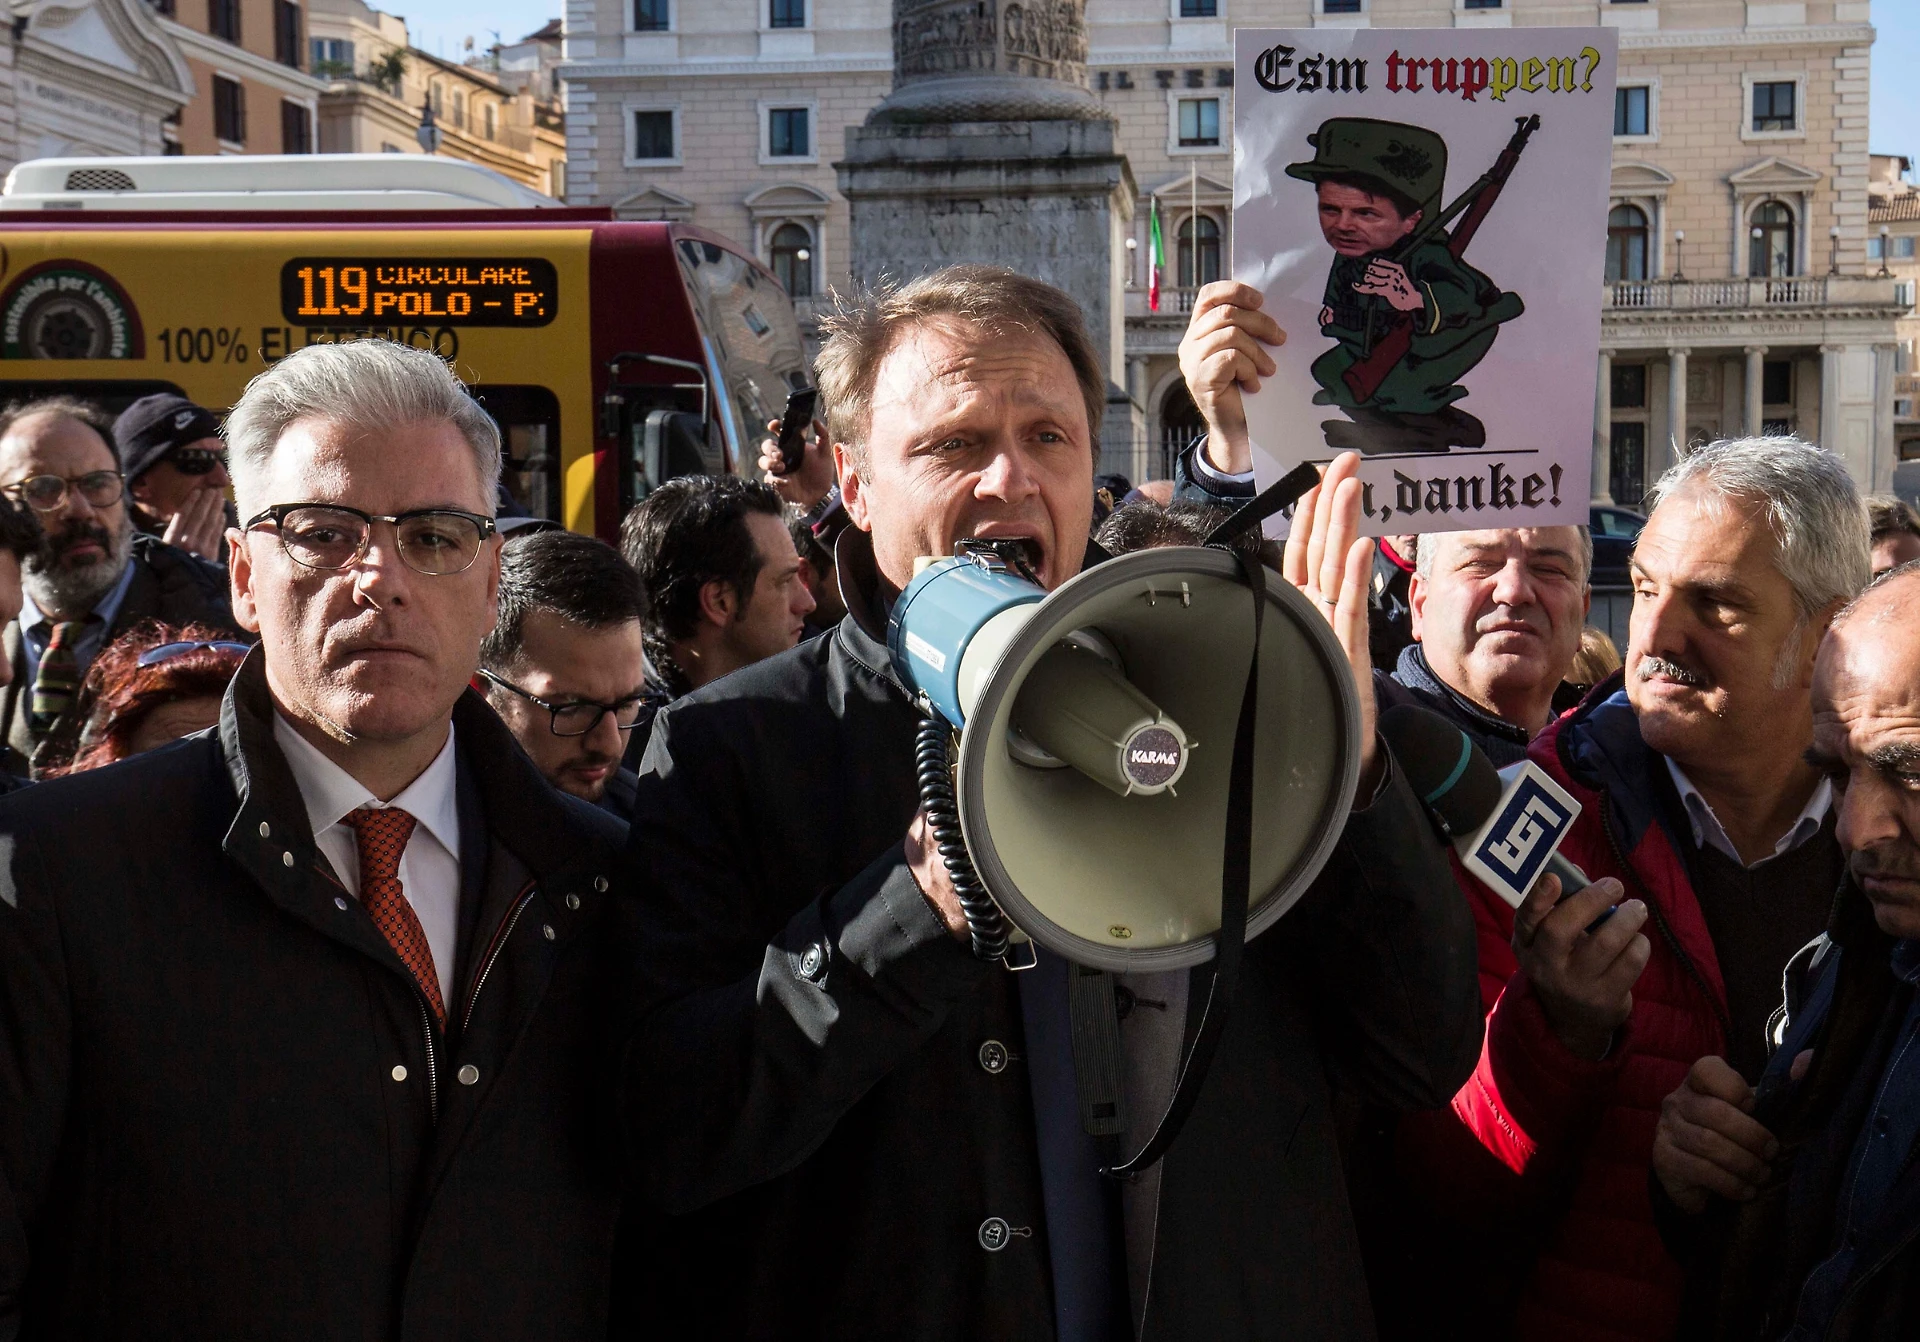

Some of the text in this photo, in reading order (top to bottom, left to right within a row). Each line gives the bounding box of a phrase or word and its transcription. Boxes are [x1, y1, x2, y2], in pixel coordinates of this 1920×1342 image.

[1099, 71, 1134, 89] IL
[1254, 44, 1601, 102] Esm truppen?
[58, 276, 86, 292] per
[376, 267, 531, 285] CIRCULARE
[298, 267, 368, 315] 119
[374, 292, 471, 316] POLO
[157, 327, 248, 363] 100%
